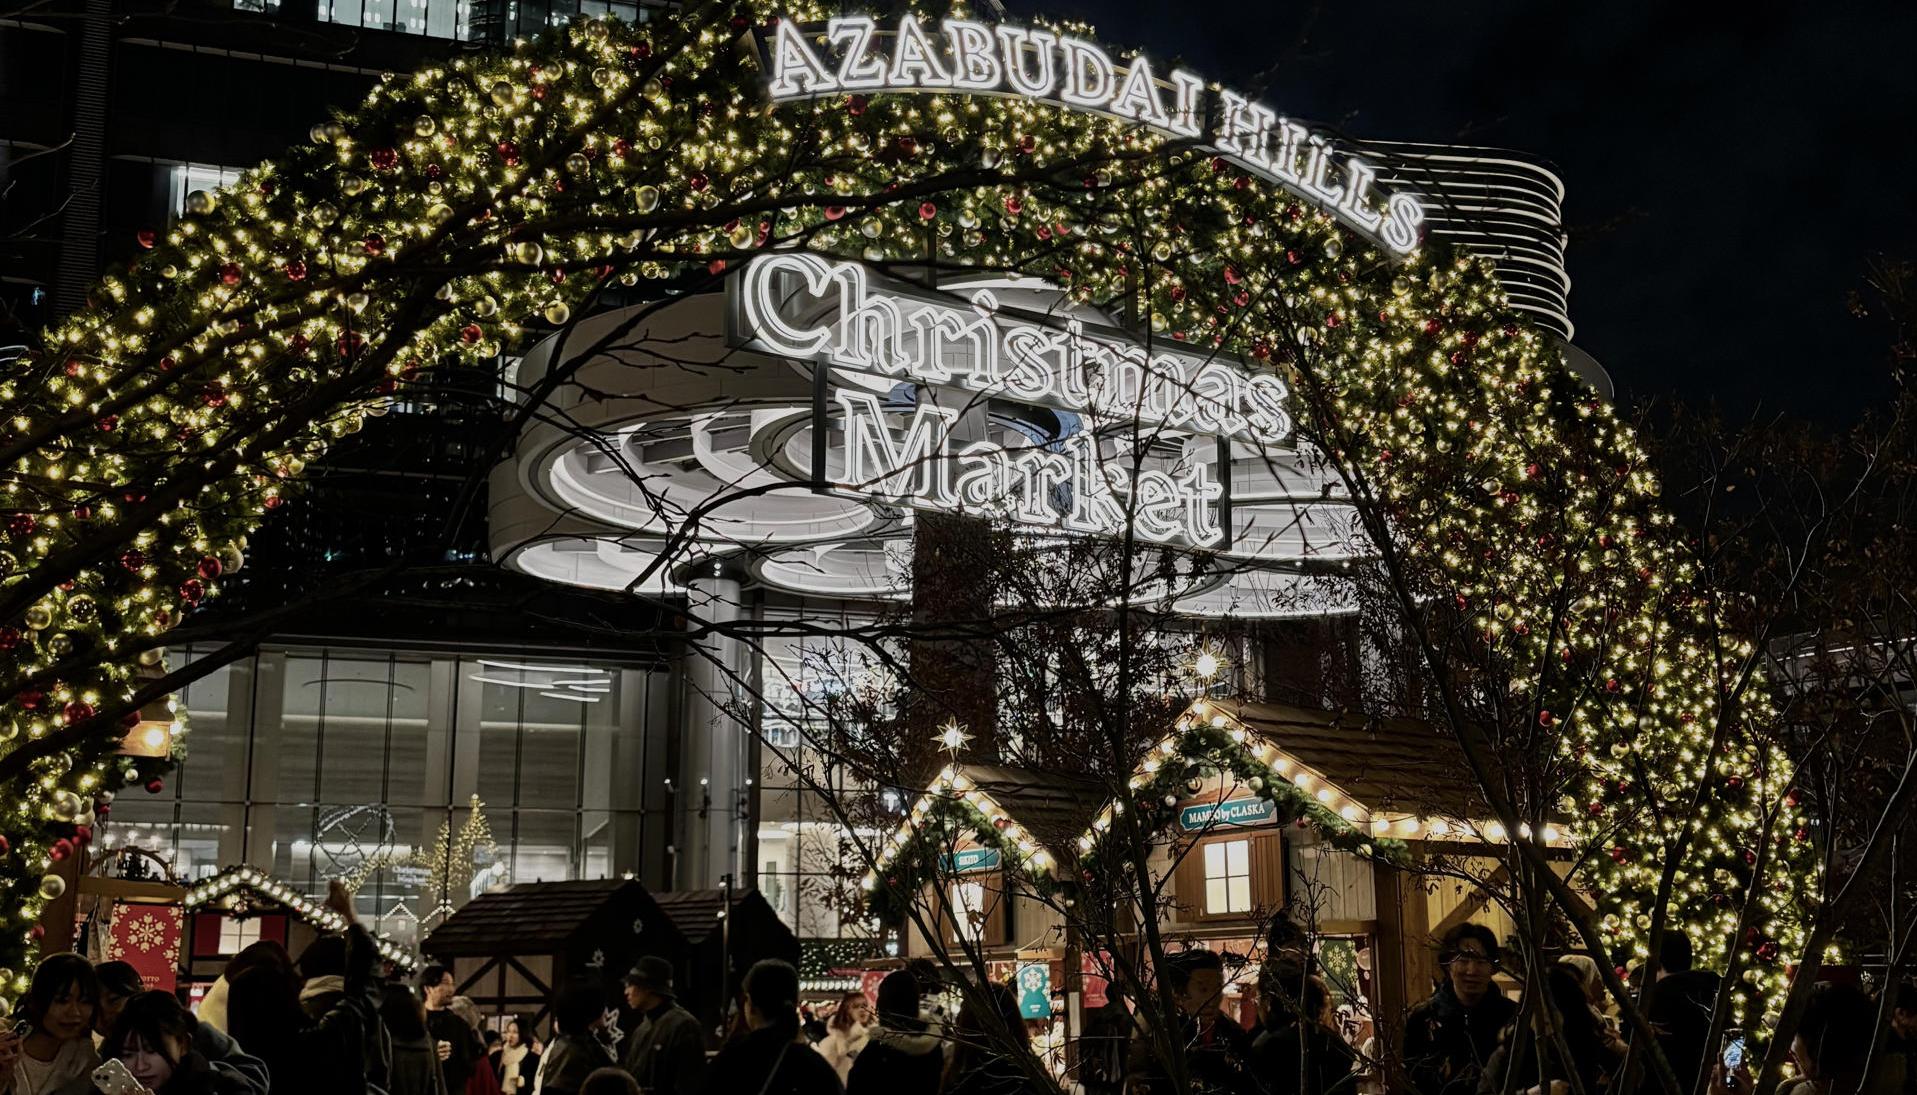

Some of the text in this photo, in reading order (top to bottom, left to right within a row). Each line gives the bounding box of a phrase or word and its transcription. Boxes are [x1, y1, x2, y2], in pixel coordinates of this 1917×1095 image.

[769, 15, 1426, 255] AZABUDAI HILLS
[743, 252, 1292, 444] Christmas
[834, 389, 1224, 548] Market
[1221, 808, 1230, 821] by
[1230, 803, 1265, 817] CLASKA
